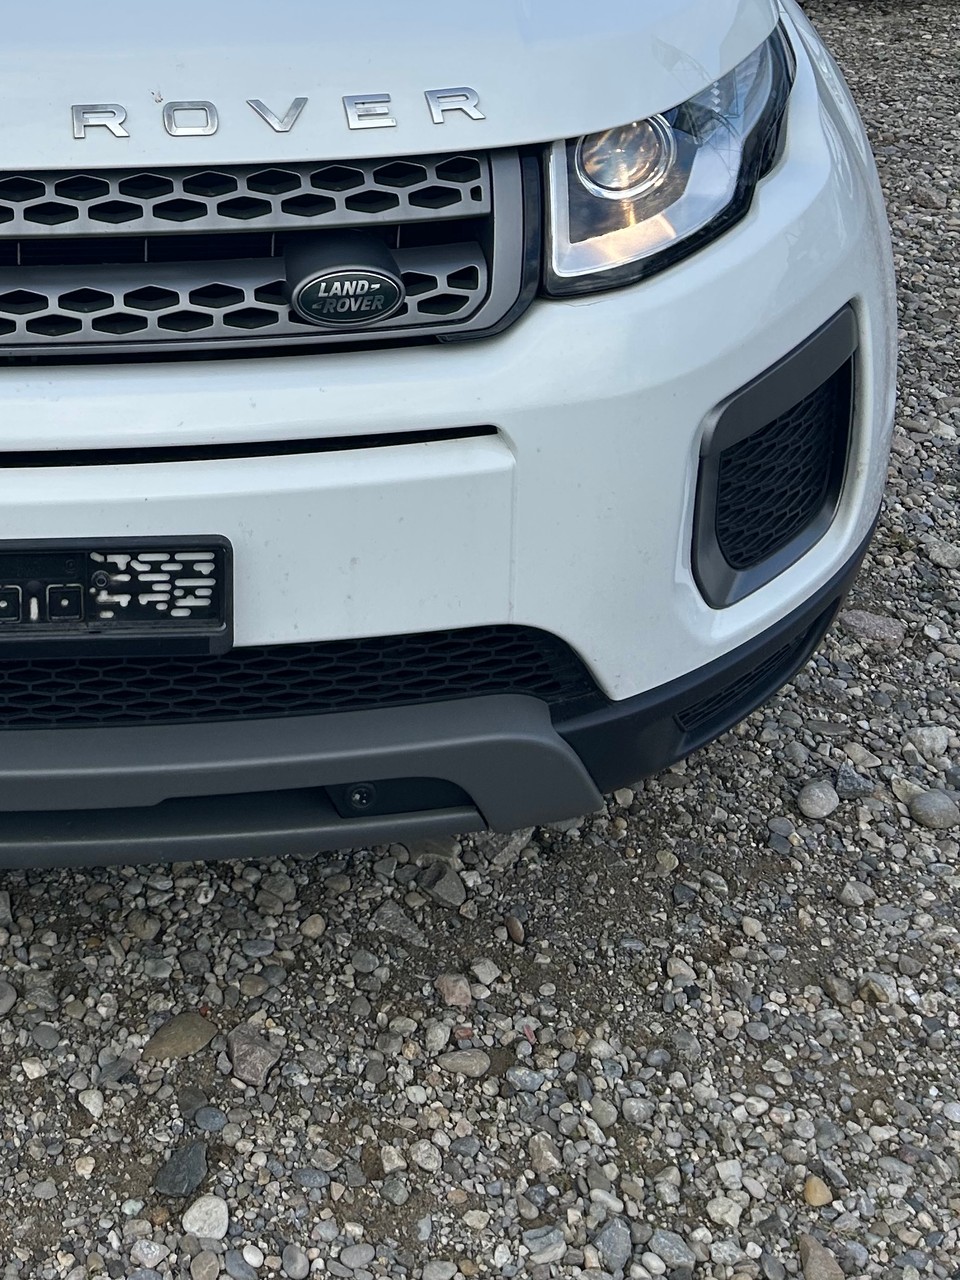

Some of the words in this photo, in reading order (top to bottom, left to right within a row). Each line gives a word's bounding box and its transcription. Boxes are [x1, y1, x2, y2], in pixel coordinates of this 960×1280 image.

[71, 86, 486, 139] ROVER
[318, 279, 369, 297] LAND
[323, 295, 385, 313] ROVER
